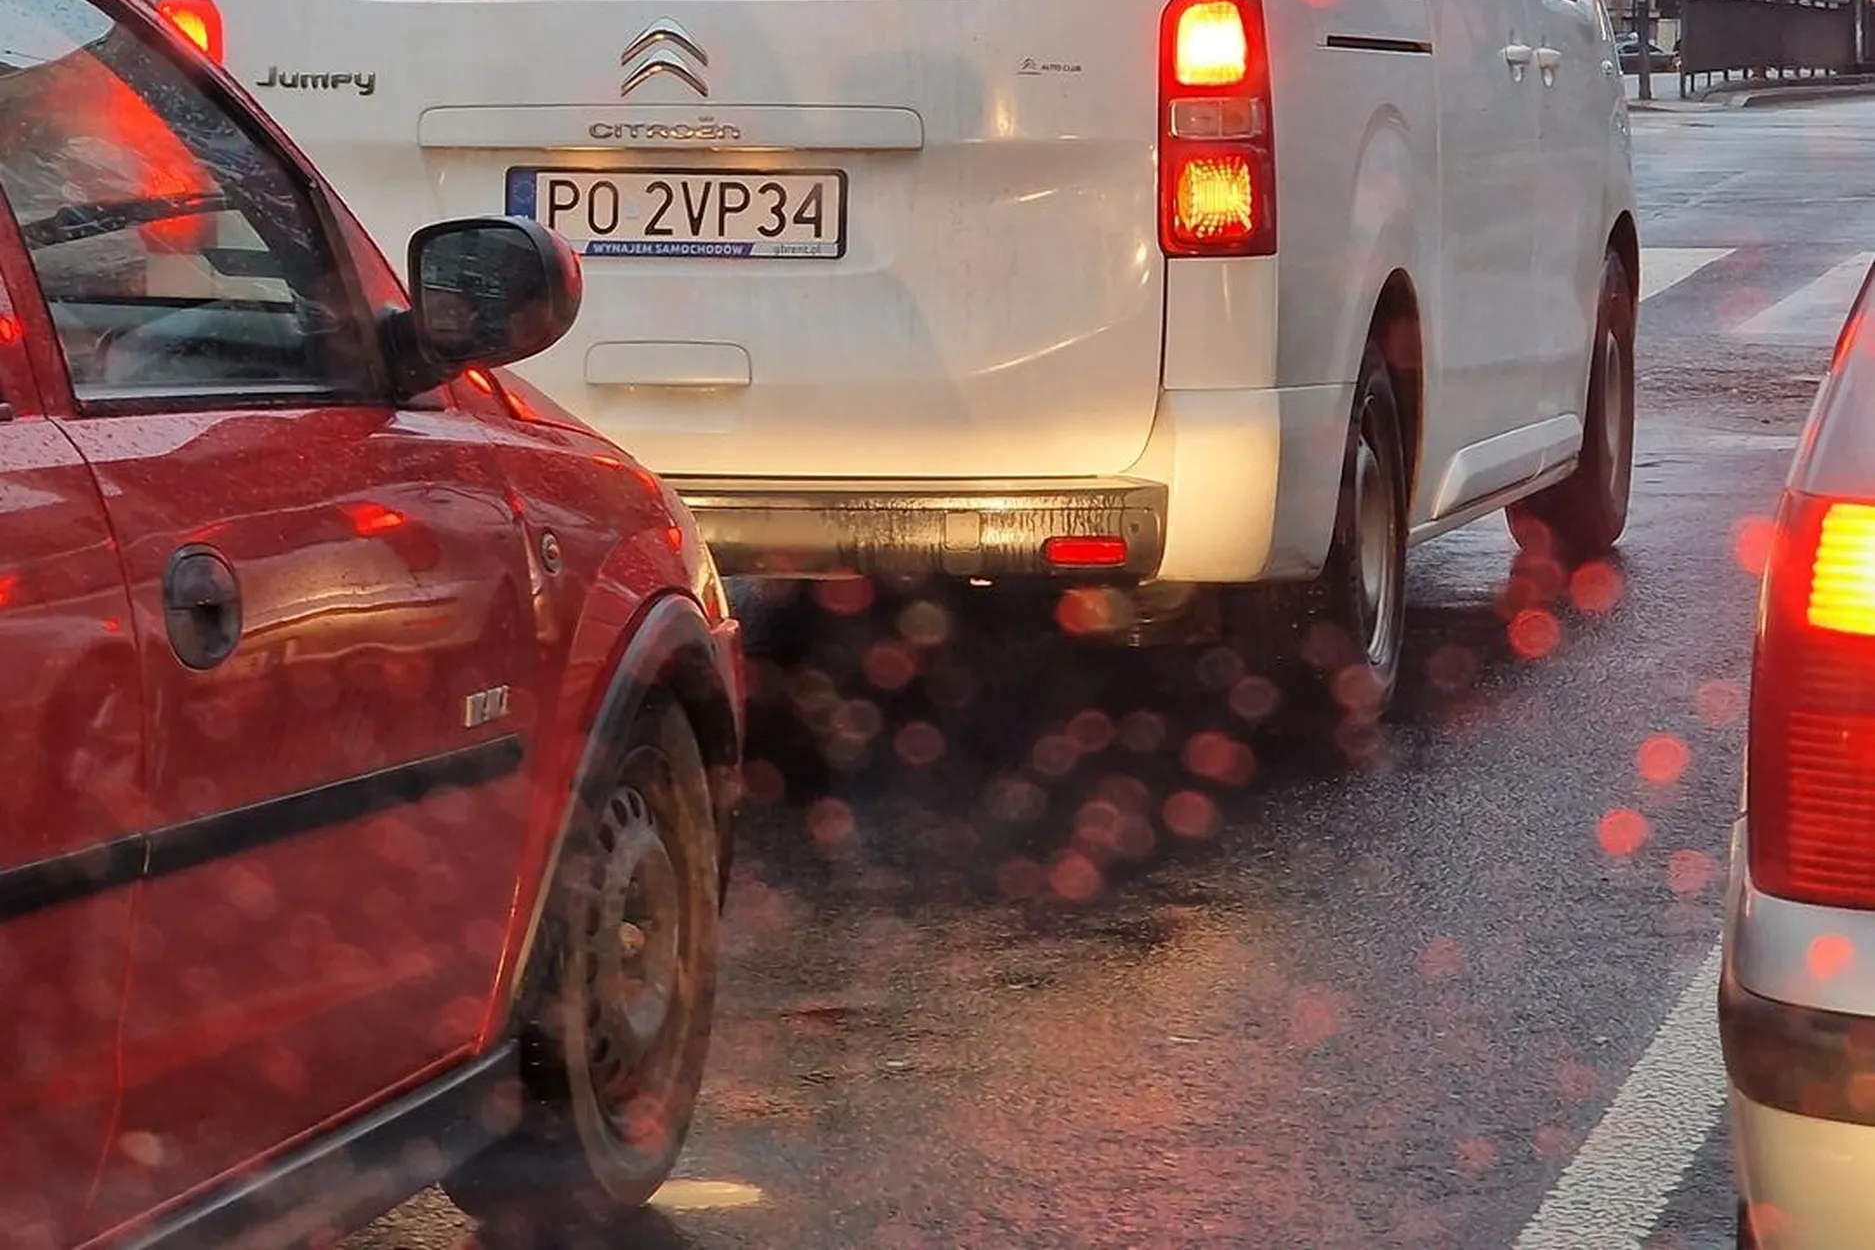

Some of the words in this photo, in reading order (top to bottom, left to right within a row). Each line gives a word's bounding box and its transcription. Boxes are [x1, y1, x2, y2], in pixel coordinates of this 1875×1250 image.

[549, 179, 619, 235] PO
[644, 180, 823, 238] 2VP34
[592, 243, 650, 255] WYNAJEM
